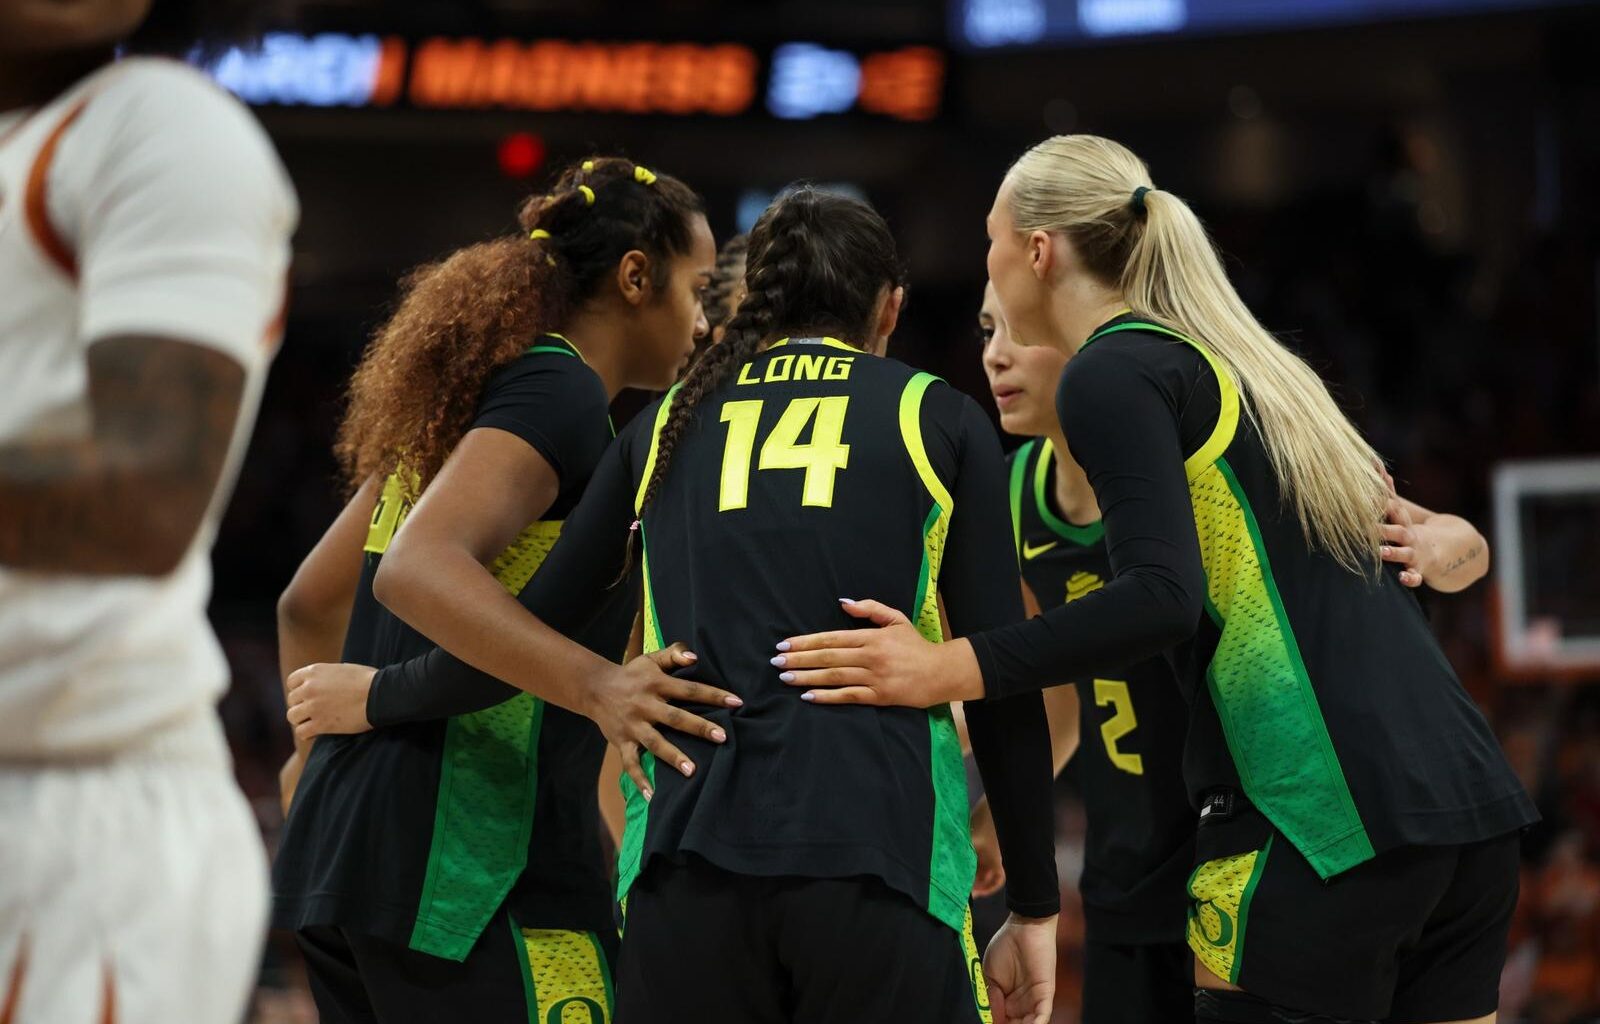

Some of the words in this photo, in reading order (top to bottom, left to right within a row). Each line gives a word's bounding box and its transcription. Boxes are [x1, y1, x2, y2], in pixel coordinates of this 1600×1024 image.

[736, 354, 855, 386] LONG
[719, 396, 850, 512] 14
[1093, 678, 1143, 775] 2
